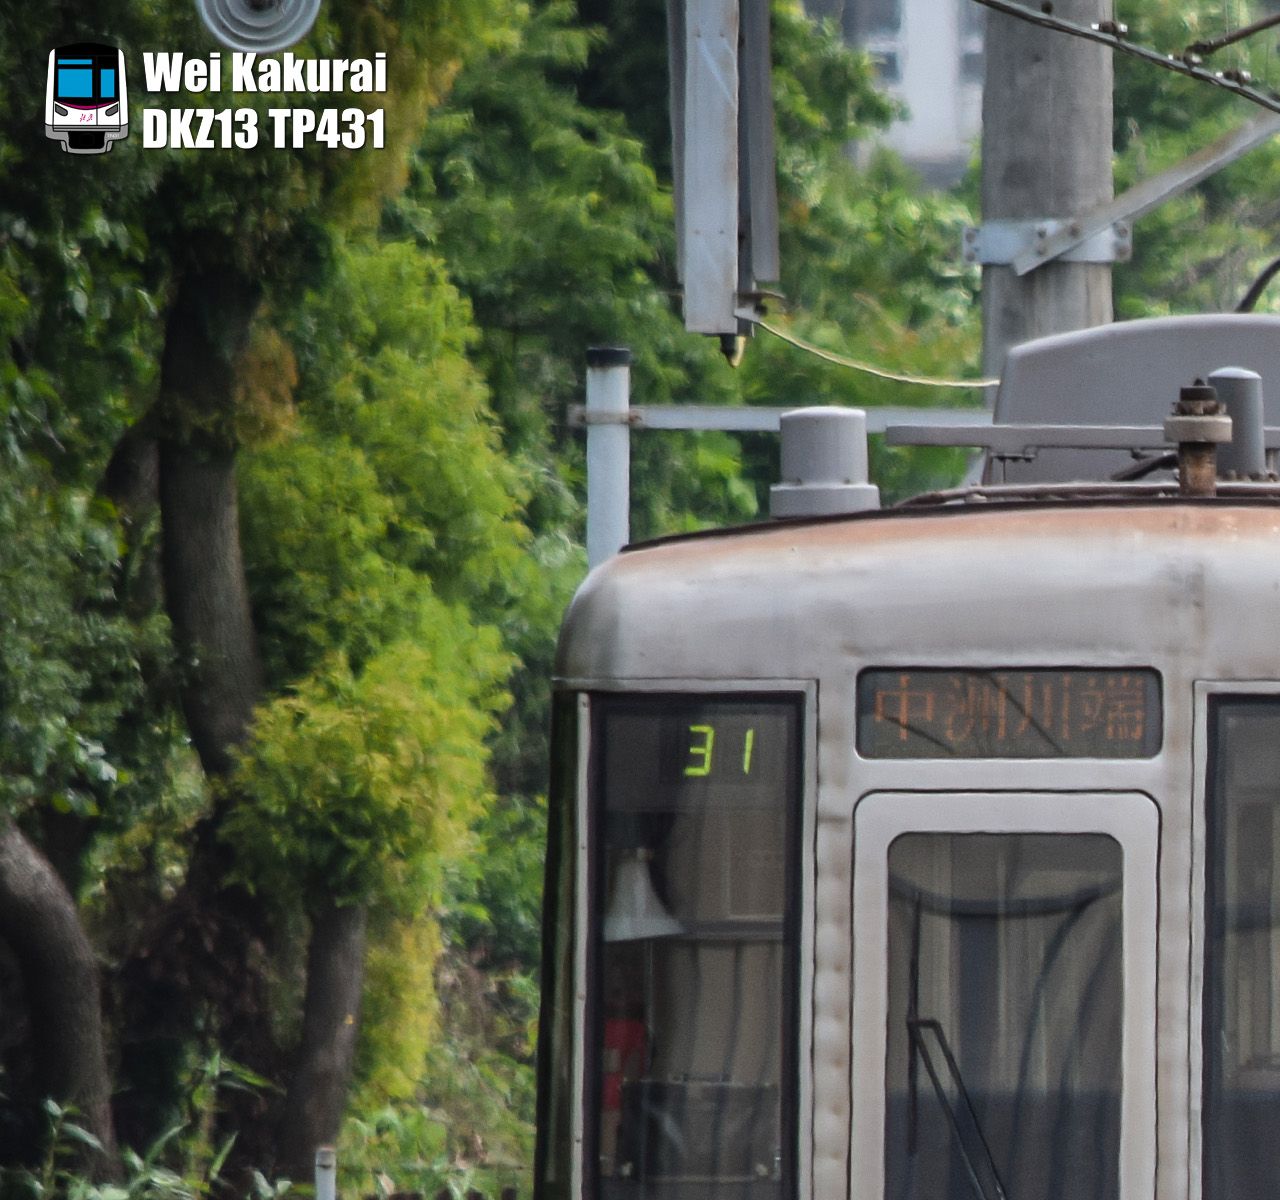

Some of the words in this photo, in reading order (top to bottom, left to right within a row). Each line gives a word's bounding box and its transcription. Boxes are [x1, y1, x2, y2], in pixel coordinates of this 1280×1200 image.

[874, 674, 1145, 741] 中洲川端
[684, 725, 754, 775] 31
